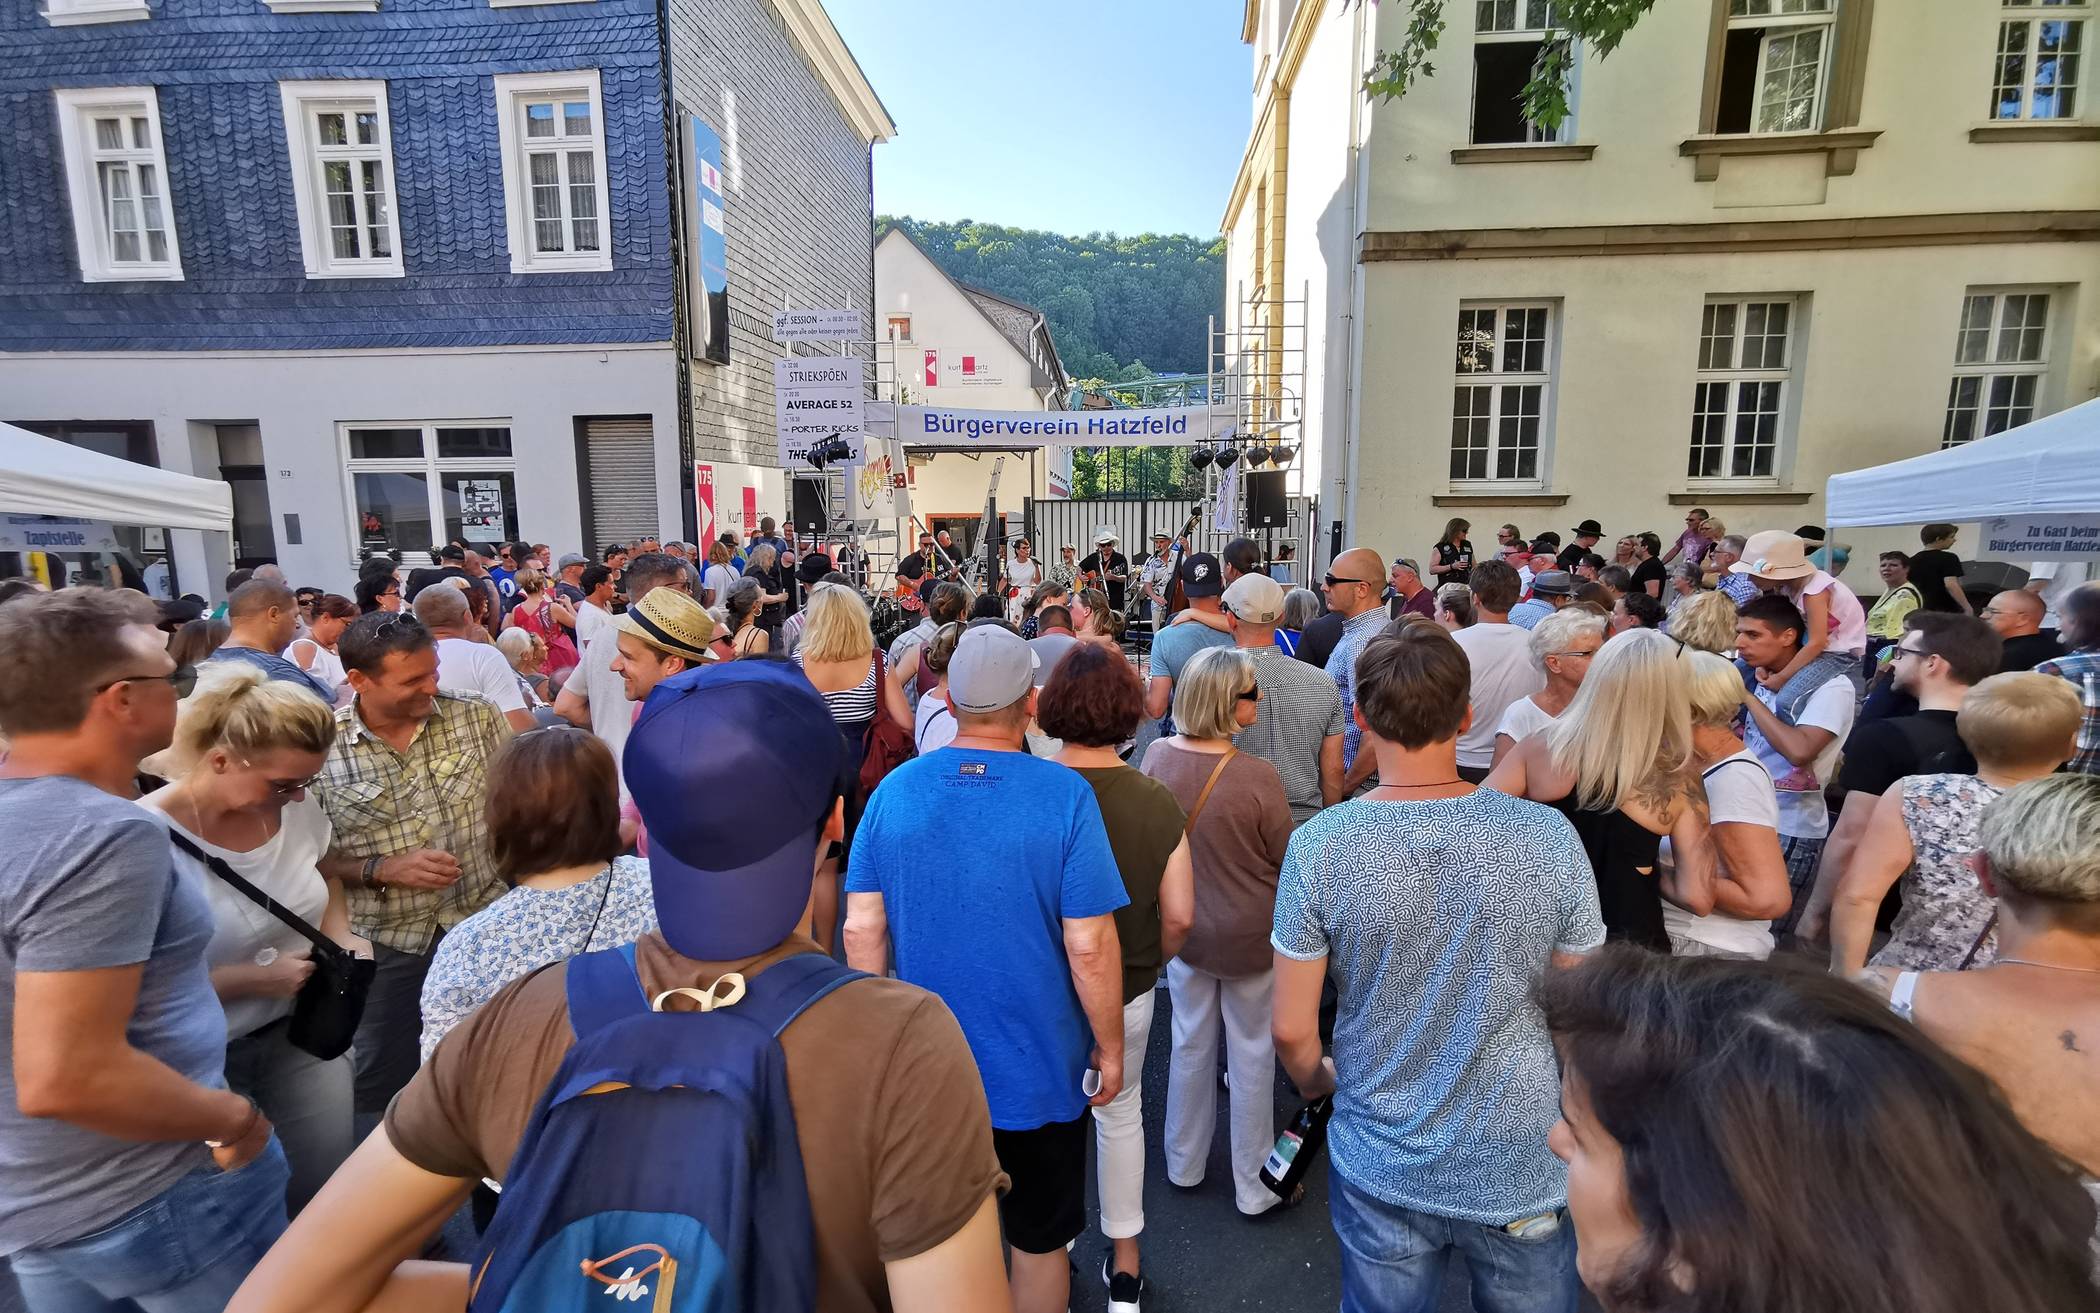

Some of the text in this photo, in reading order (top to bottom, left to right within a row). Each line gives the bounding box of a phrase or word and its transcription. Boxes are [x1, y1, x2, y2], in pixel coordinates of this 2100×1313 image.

[790, 315, 818, 325] SESSION
[789, 368, 848, 382] STRIEKSPÖEN
[786, 400, 853, 410] AVERAGE 52
[791, 425, 829, 433] PORTER
[831, 424, 859, 433] RICKS
[924, 413, 1187, 438] Bürgerverein Hatzfeld
[788, 449, 808, 460] THE
[698, 469, 713, 485] 175
[2027, 525, 2041, 537] Zu
[2043, 525, 2068, 537] Gast
[1988, 540, 2061, 552] Bürgerverein
[970, 781, 997, 789] DAVID
